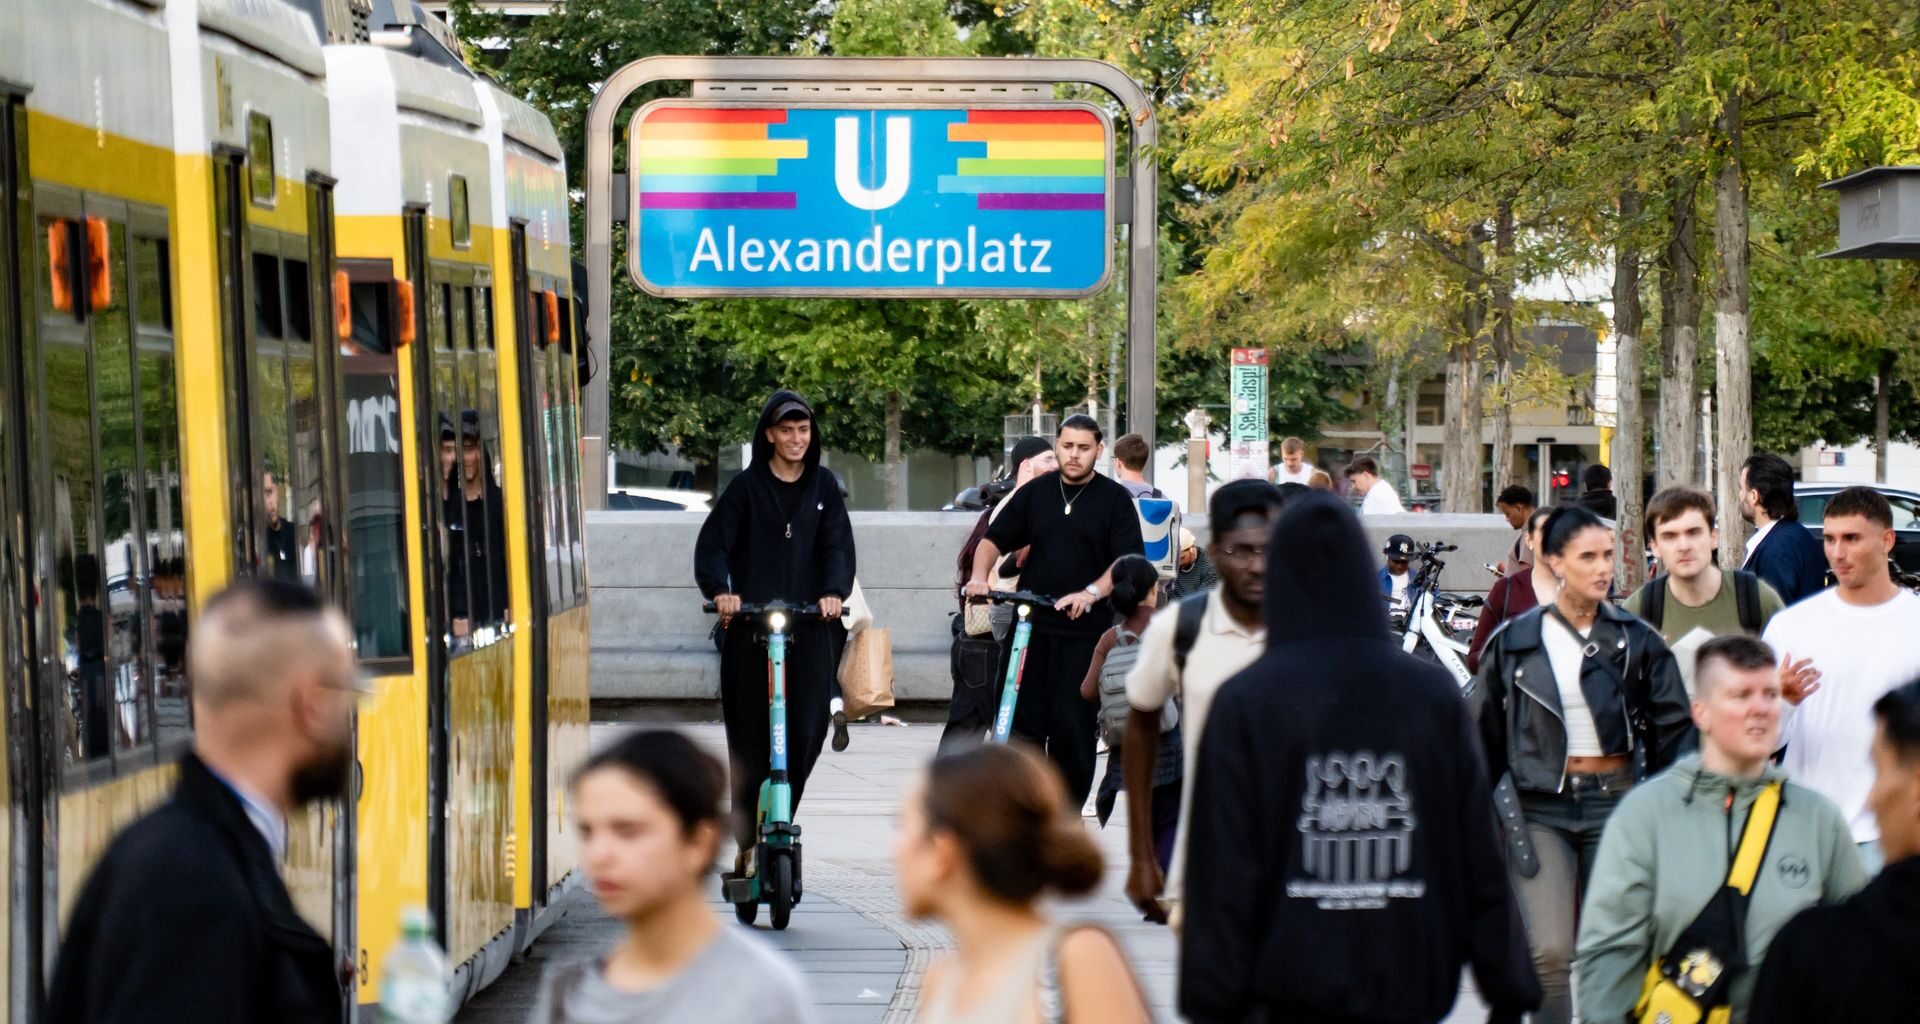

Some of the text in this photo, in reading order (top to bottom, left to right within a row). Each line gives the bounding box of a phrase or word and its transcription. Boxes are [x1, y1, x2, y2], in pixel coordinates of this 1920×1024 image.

[835, 117, 911, 210] U
[689, 225, 1053, 285] Alexanderplatz
[774, 722, 785, 755] dott
[996, 704, 1011, 735] dott
